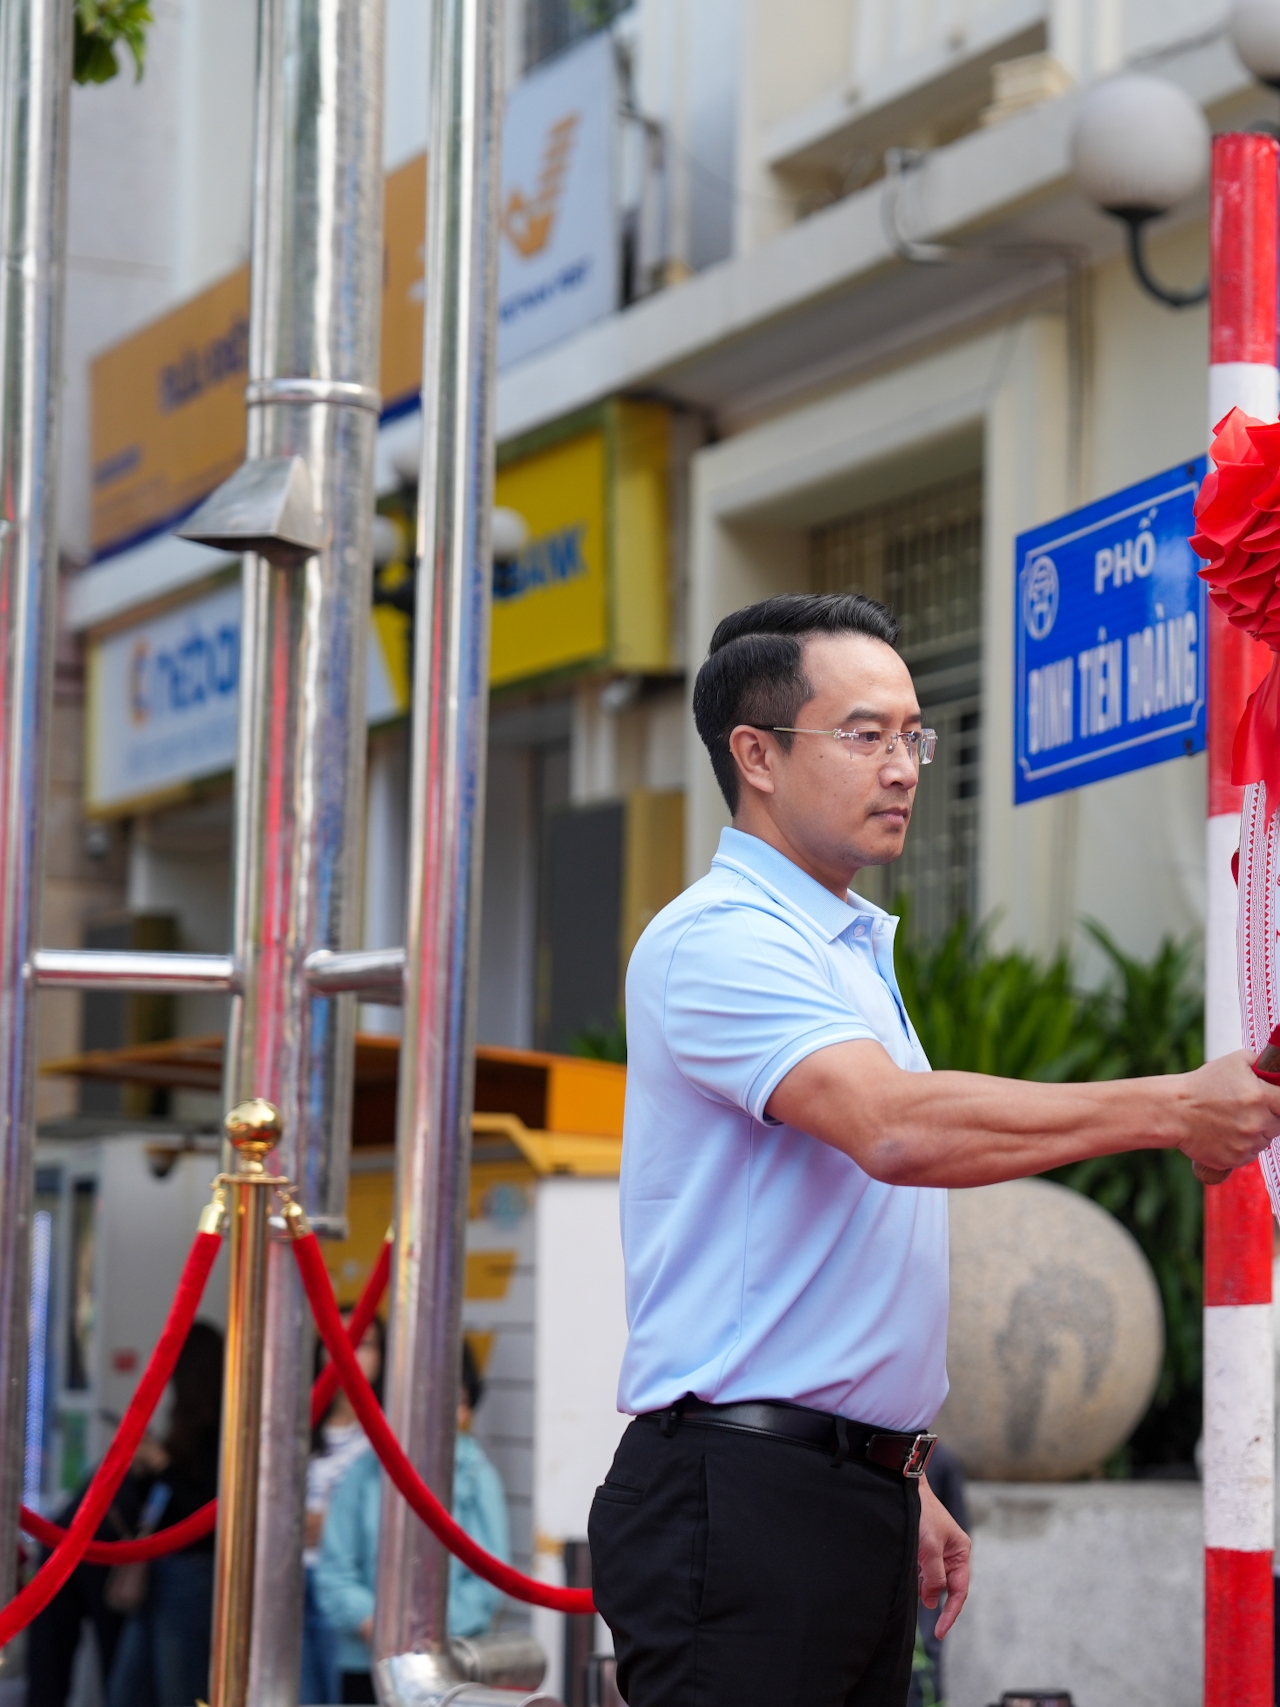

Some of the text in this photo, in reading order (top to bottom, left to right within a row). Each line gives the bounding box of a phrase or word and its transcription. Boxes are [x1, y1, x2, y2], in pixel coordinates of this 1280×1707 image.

[1094, 506, 1158, 595] PHỐ
[1028, 602, 1198, 755] ĐINH TIÊN HOÀNG
